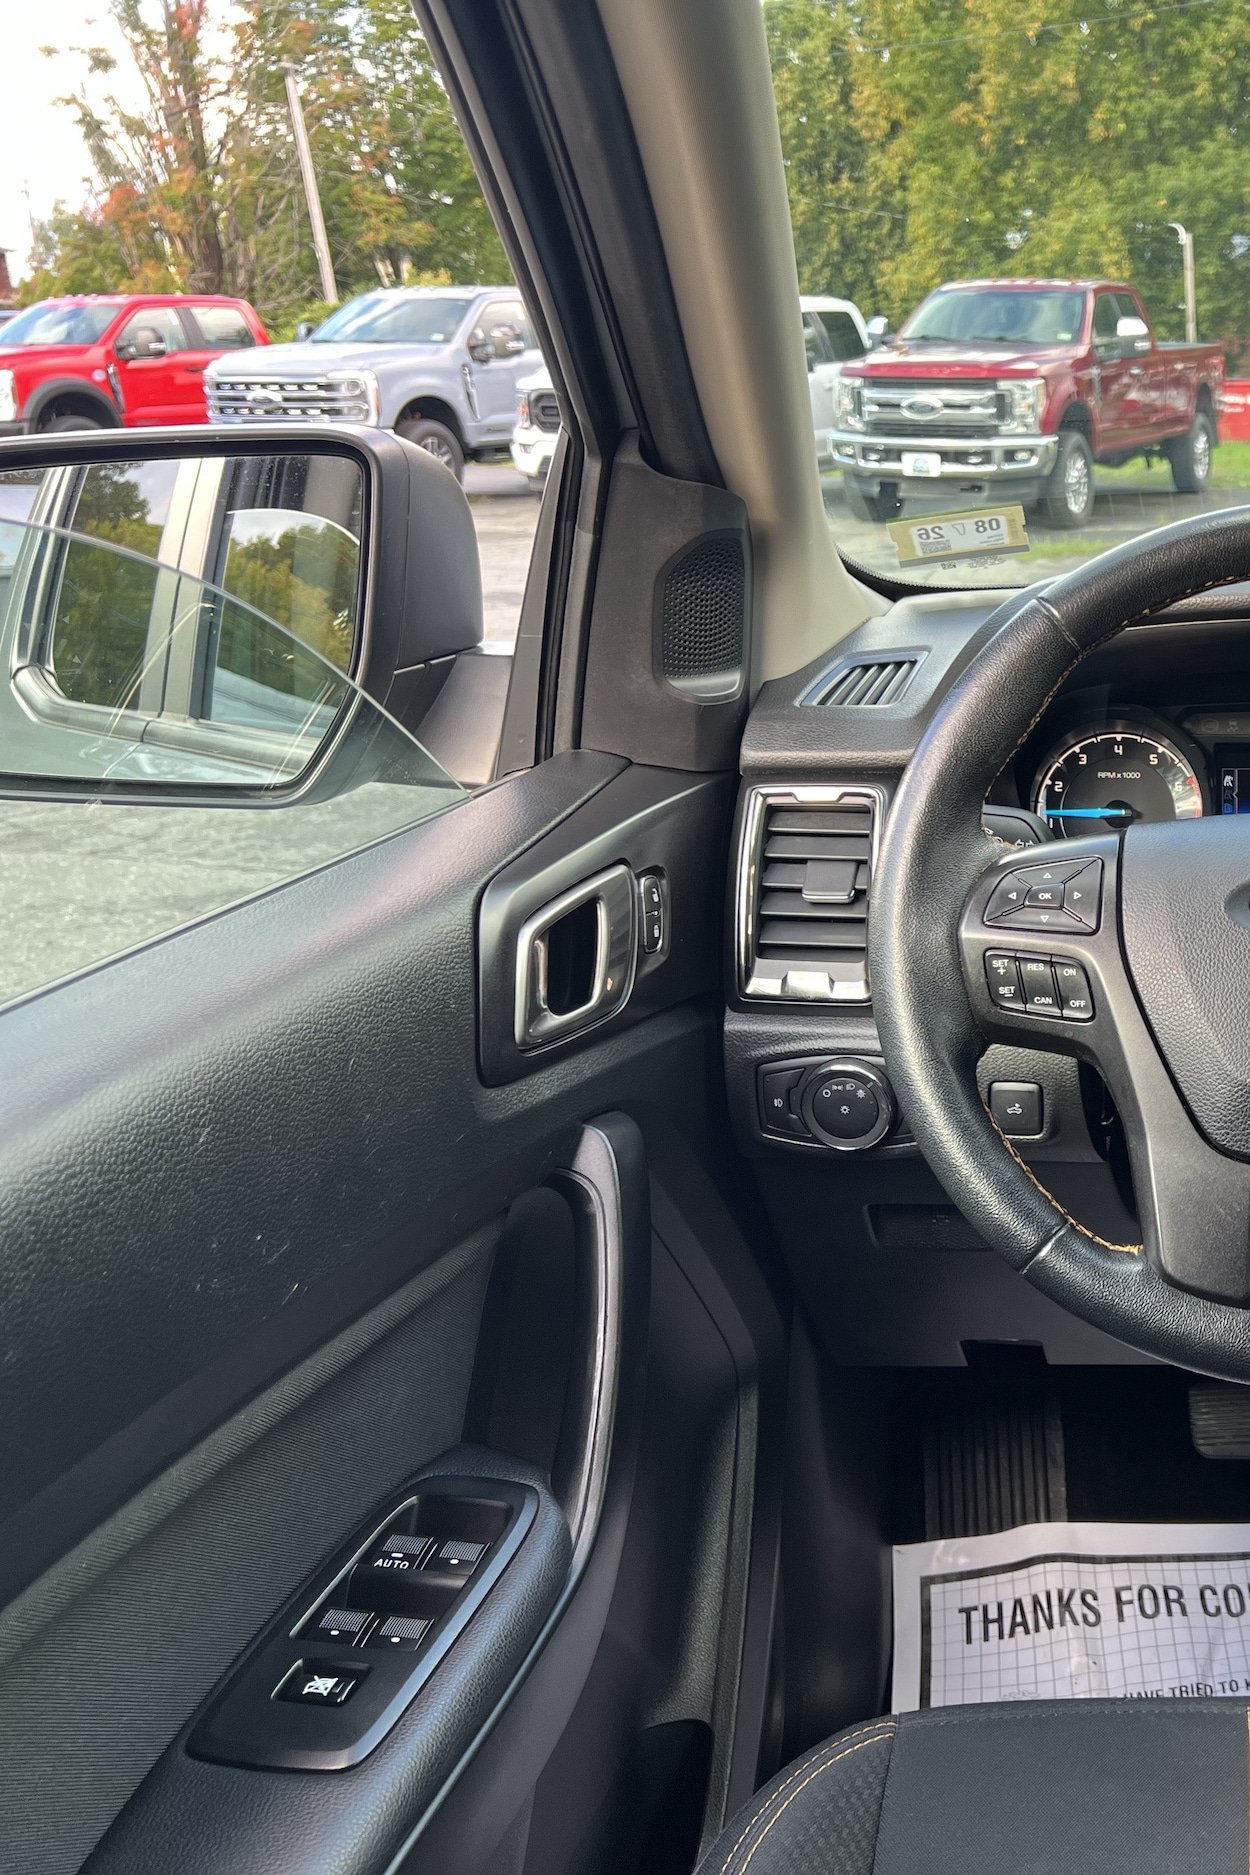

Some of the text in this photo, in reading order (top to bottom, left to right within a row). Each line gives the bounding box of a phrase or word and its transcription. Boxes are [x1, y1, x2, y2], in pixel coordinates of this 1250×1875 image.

[1114, 745, 1123, 755] 4
[1078, 754, 1087, 765] 3
[1149, 754, 1159, 765] 5
[1054, 781, 1063, 792] 2
[1174, 782, 1183, 791] 6
[992, 959, 1009, 967] SET
[1027, 963, 1044, 971] RES
[373, 1558, 410, 1570] AUTO
[958, 1588, 1101, 1645] THANKS
[1116, 1584, 1188, 1623] FOR
[1169, 1683, 1213, 1698] TRIED
[1219, 1680, 1239, 1694] TO
